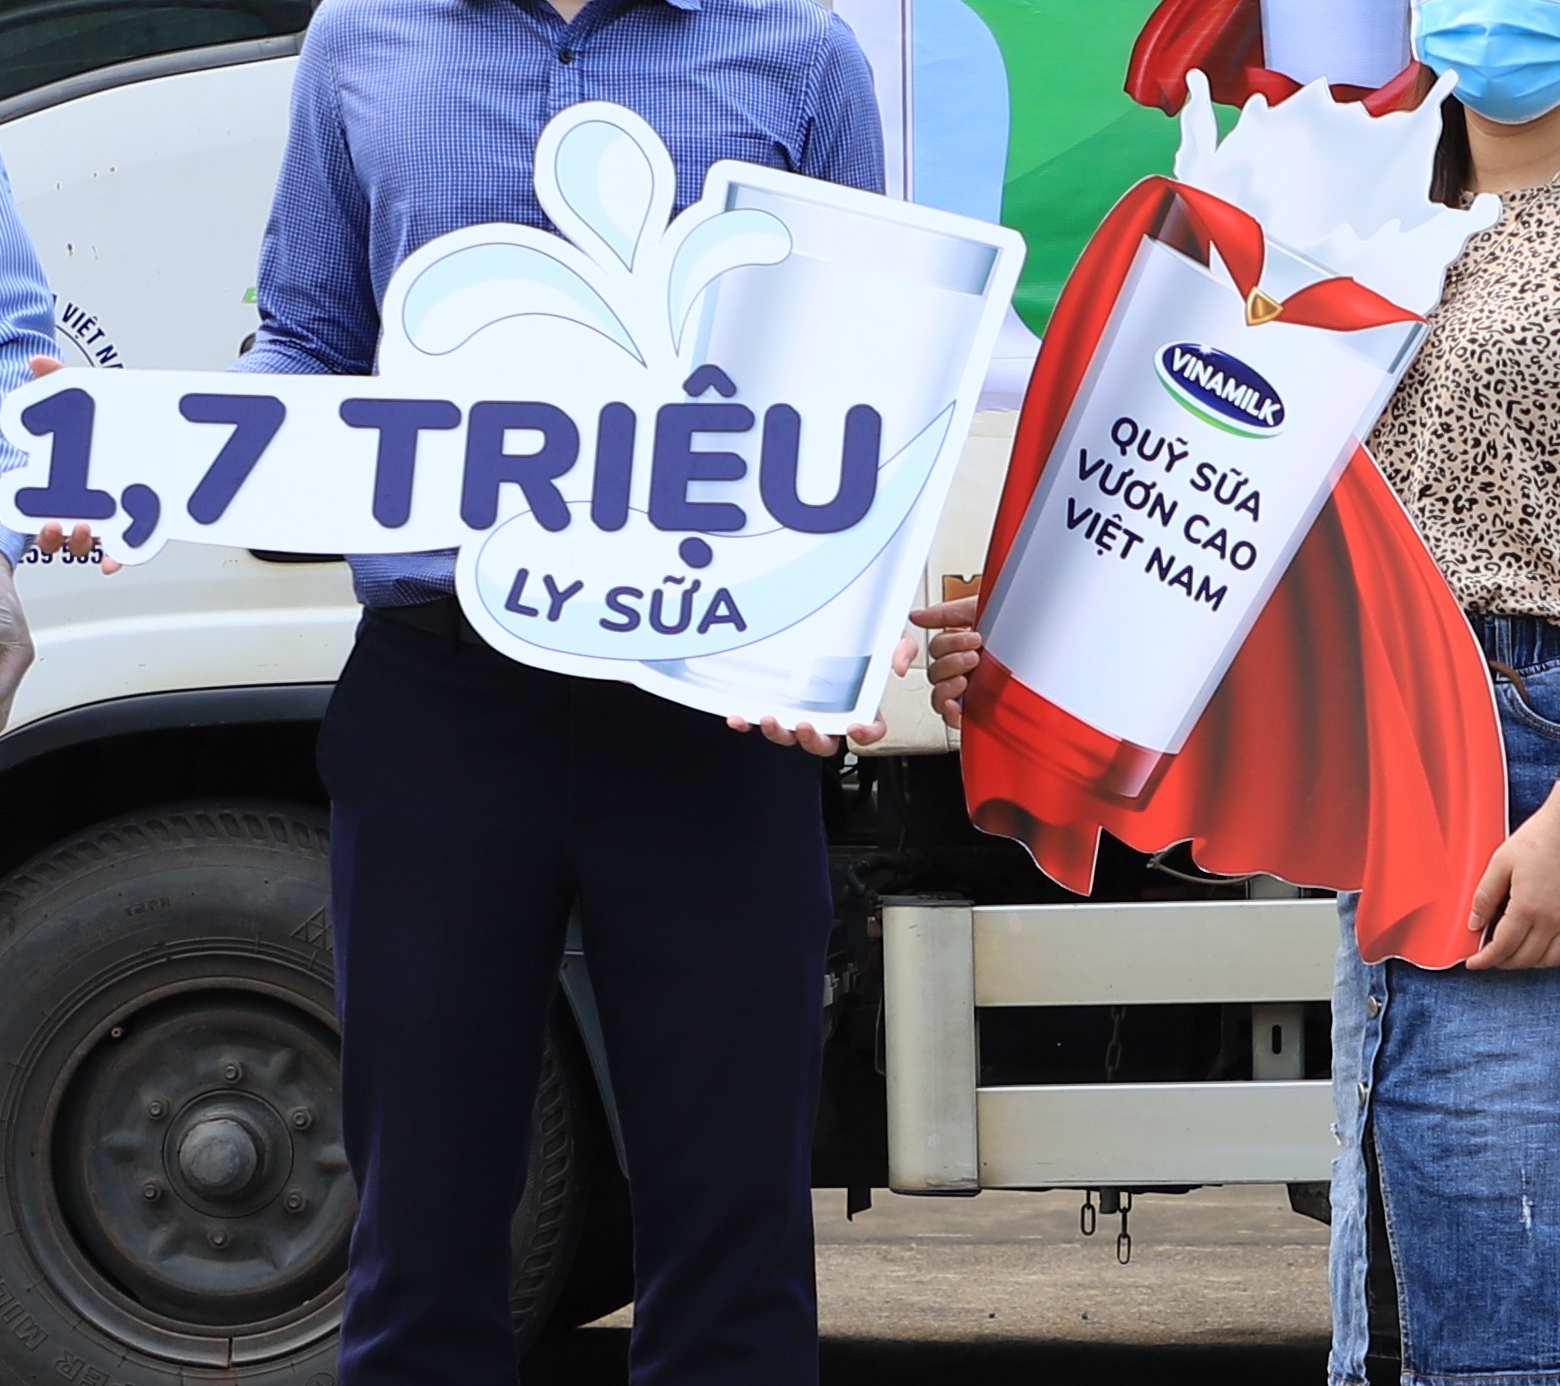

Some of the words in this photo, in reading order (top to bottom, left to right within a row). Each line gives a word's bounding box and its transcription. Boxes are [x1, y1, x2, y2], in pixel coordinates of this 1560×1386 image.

[60, 302, 106, 344] VIỆT
[1170, 345, 1284, 427] VINAMILK
[15, 390, 285, 552] 1,7
[340, 365, 881, 566] TRIỆU
[1077, 449, 1170, 518] VƯƠN
[1184, 515, 1256, 570] CAO
[1112, 417, 1188, 472] QUỸ
[1191, 463, 1259, 521] SỮA
[504, 568, 586, 622] LY
[608, 575, 748, 636] SỮA
[1067, 498, 1143, 559] VIỆT
[1146, 548, 1227, 611] NAM
